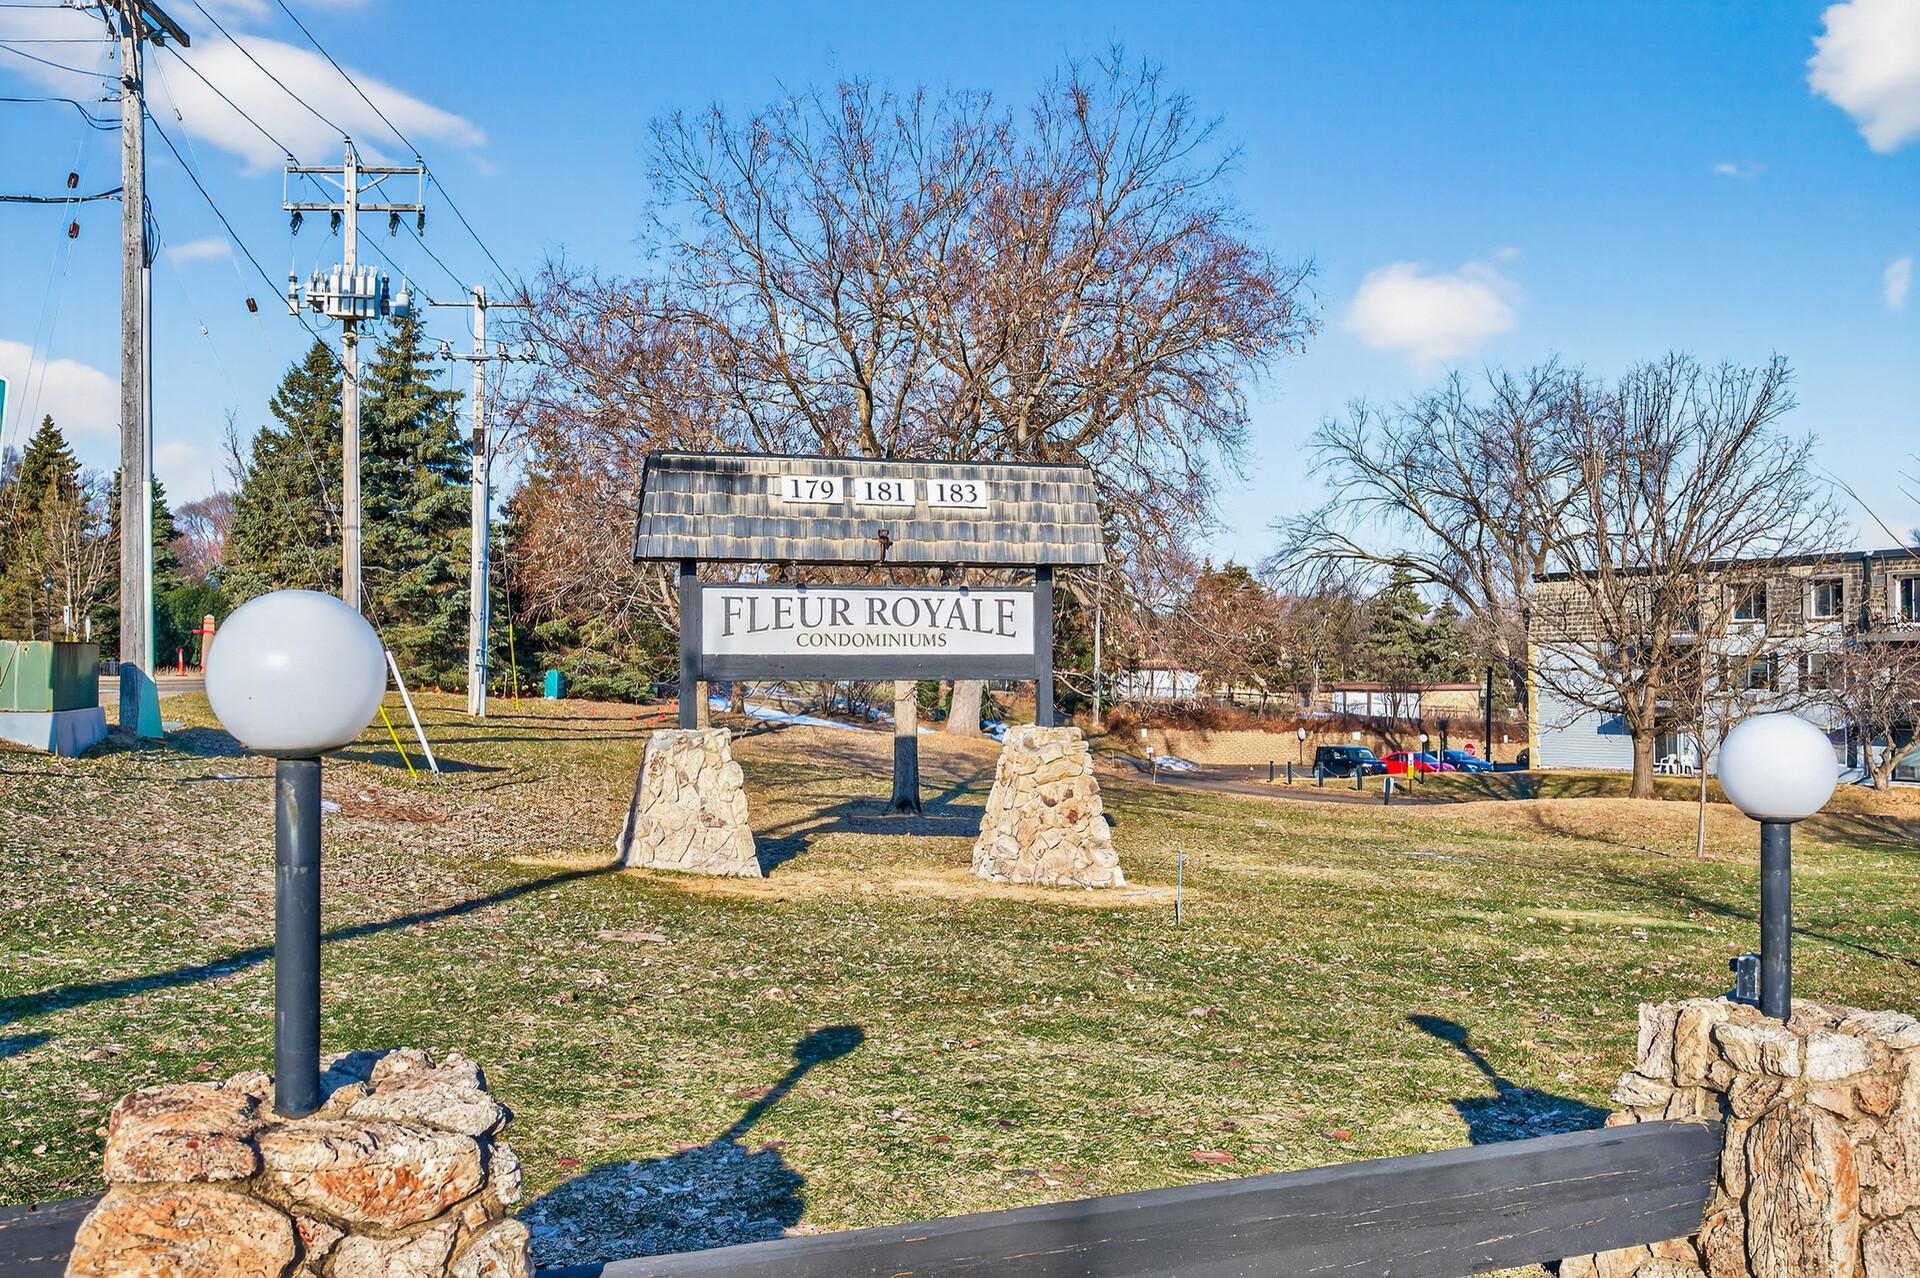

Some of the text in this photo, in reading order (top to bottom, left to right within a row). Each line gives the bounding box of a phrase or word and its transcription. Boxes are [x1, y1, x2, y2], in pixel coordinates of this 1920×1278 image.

[791, 478, 834, 501] 179
[864, 480, 906, 502] 181
[936, 483, 978, 504] 183
[721, 595, 1017, 638] FLEUR ROYALE
[796, 632, 947, 648] CONDOMINIUMS
